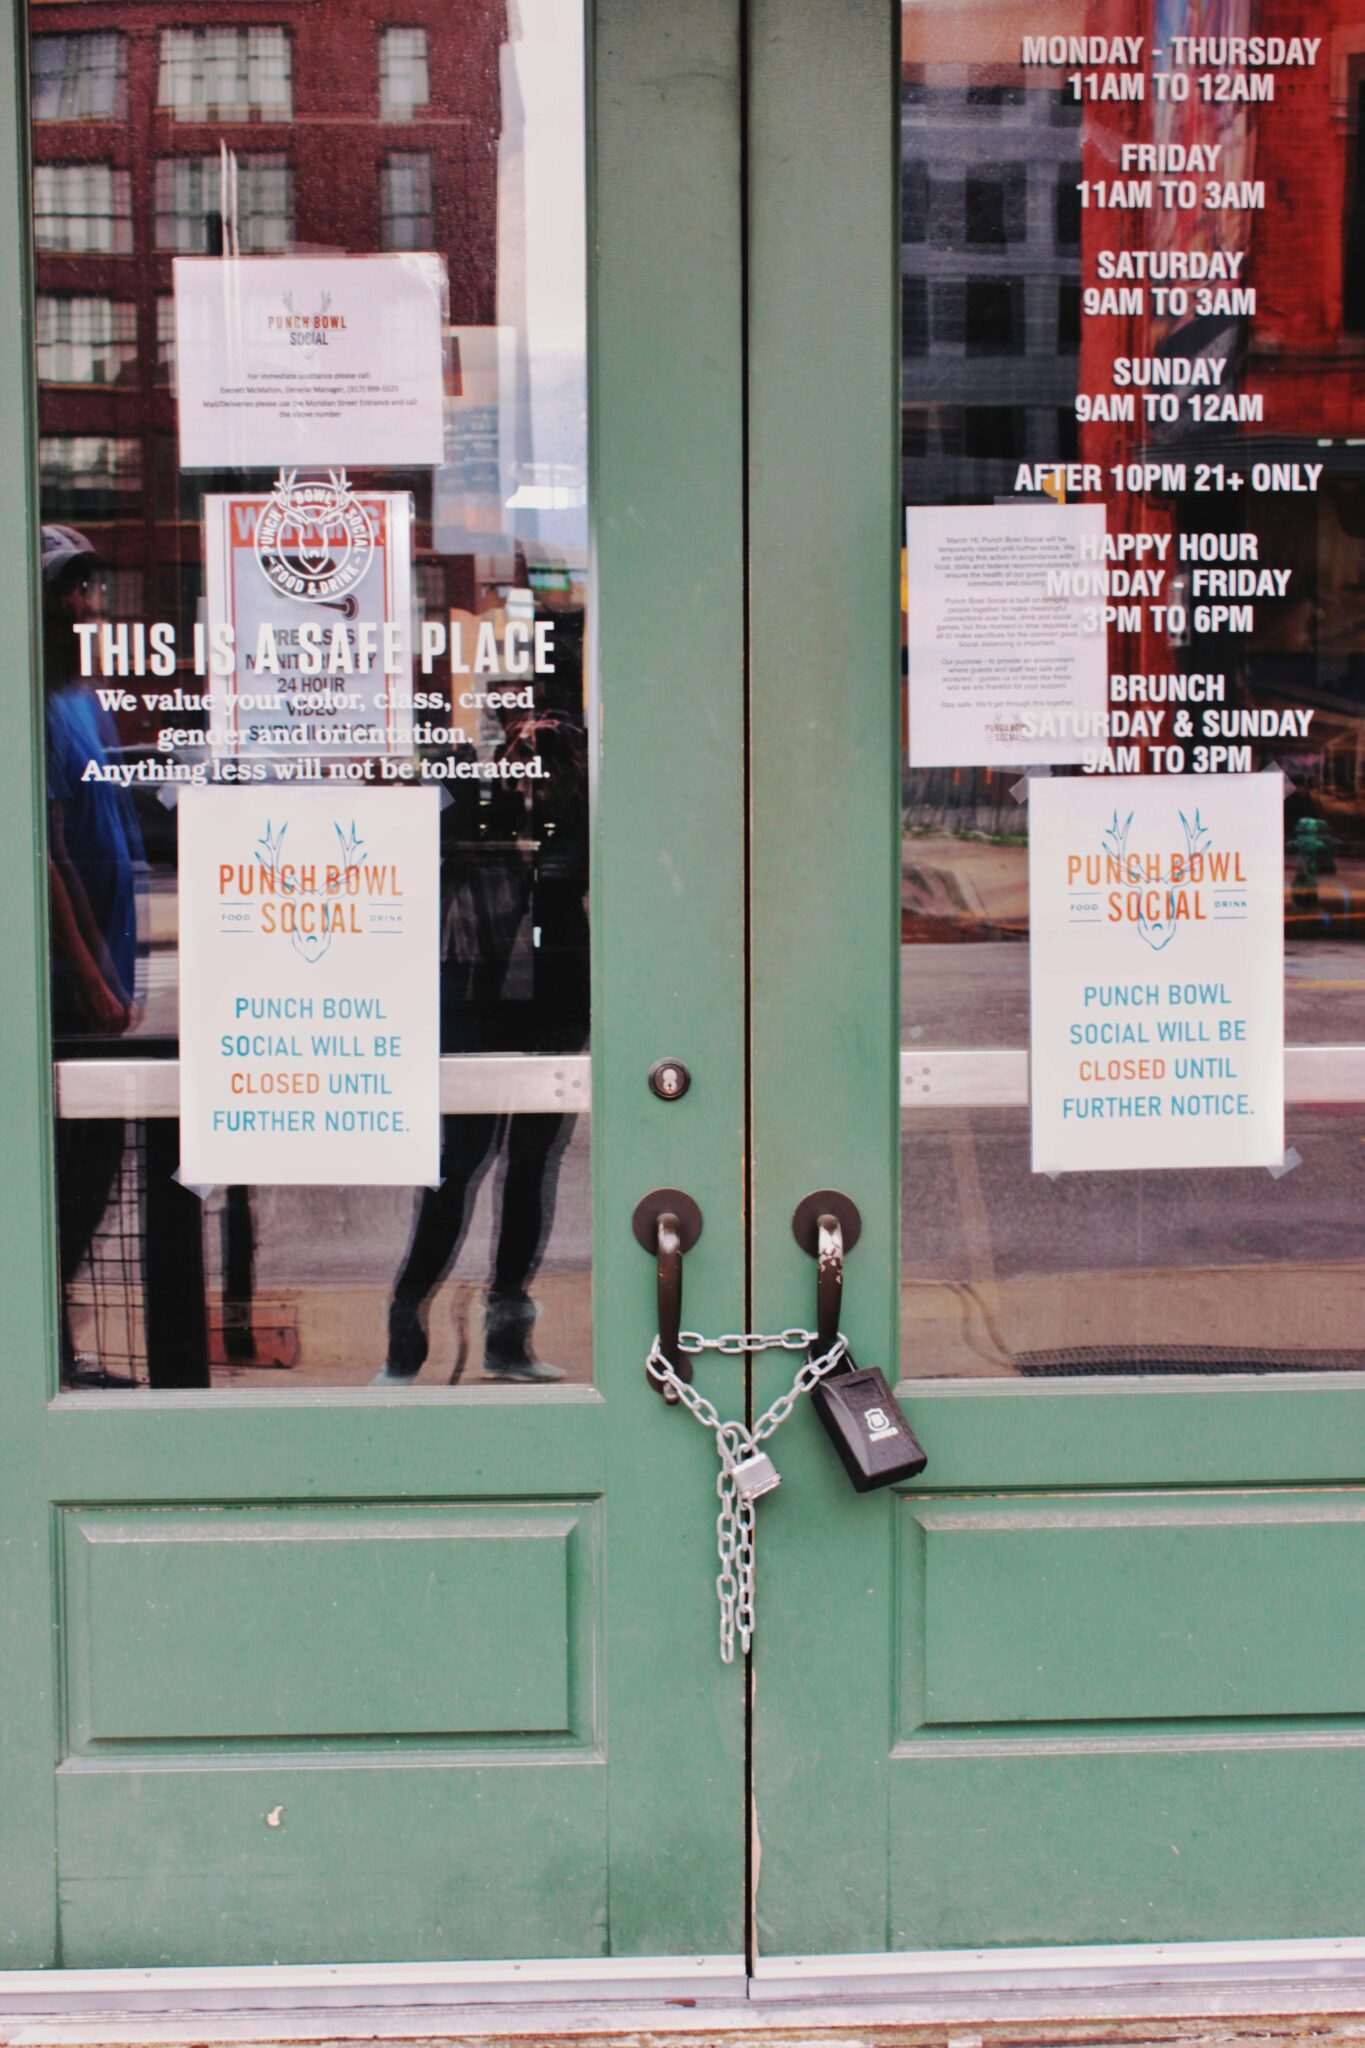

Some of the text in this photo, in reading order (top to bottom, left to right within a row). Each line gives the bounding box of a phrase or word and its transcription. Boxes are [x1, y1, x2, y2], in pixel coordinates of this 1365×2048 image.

[1022, 36, 1144, 65] MONDAY
[1171, 37, 1321, 65] THURSDAY
[1068, 73, 1275, 102] 11AM TO 12AM
[1121, 144, 1222, 172] FRIDAY
[1076, 181, 1265, 209] 11AM TO 3AM
[1097, 251, 1244, 279] SATURDAY
[1083, 288, 1256, 316] 9AM TO 3AM
[268, 315, 347, 328] PUNCH BOWL
[290, 332, 328, 345] SOCIAL
[334, 372, 356, 381] please
[1113, 358, 1227, 386] SUNDAY
[255, 400, 276, 409] please
[1075, 394, 1264, 422] 9AM TO 12AM
[1014, 464, 1323, 492] AFTER 10PM 21+ ONLY
[294, 488, 333, 506] BOWL
[261, 509, 282, 554] PUNCH
[345, 508, 369, 553] SOCIAL
[1080, 533, 1258, 561] HAPPY HOUR
[270, 565, 305, 592] FOOD
[320, 564, 359, 594] DRINK
[1046, 569, 1165, 597] MONDAY
[1192, 569, 1292, 597] FRIDAY
[1083, 605, 1254, 633] 3PM TO 6PM
[73, 621, 555, 676] THIS IS A SAFE PLACE
[277, 678, 345, 692] 24 HOUR
[1110, 674, 1225, 702] BRUNCH
[96, 686, 535, 717] We value your color, class, creed
[157, 721, 473, 753] gender and orientation.
[1020, 710, 1165, 738] SATURDAY
[1173, 710, 1193, 738] &
[1202, 710, 1314, 738] SUNDAY
[81, 756, 550, 787] Anything less will not be tolerated.
[1082, 746, 1252, 774] 9AM TO 3PM
[219, 864, 403, 896] PUNCH BOWL
[1067, 852, 1247, 886] PUNCH BOWL
[261, 902, 363, 933] SOCIAL
[370, 914, 403, 922] DRINK
[1108, 890, 1207, 922] SOCIAL
[1214, 900, 1248, 908] DRINK
[235, 998, 387, 1019] PUNCH BOWL
[1084, 983, 1231, 1007] PUNCH BOWL
[221, 1036, 402, 1057] SOCIAL WILL BE
[1070, 1020, 1247, 1045] SOCIAL WILL BE
[1079, 1057, 1237, 1081] CLOSED UNTIL
[231, 1073, 392, 1094] CLOSED UNTIL
[1063, 1094, 1255, 1119] FURTHER NOTICE.
[213, 1111, 410, 1132] FURTHER NOTICE.
